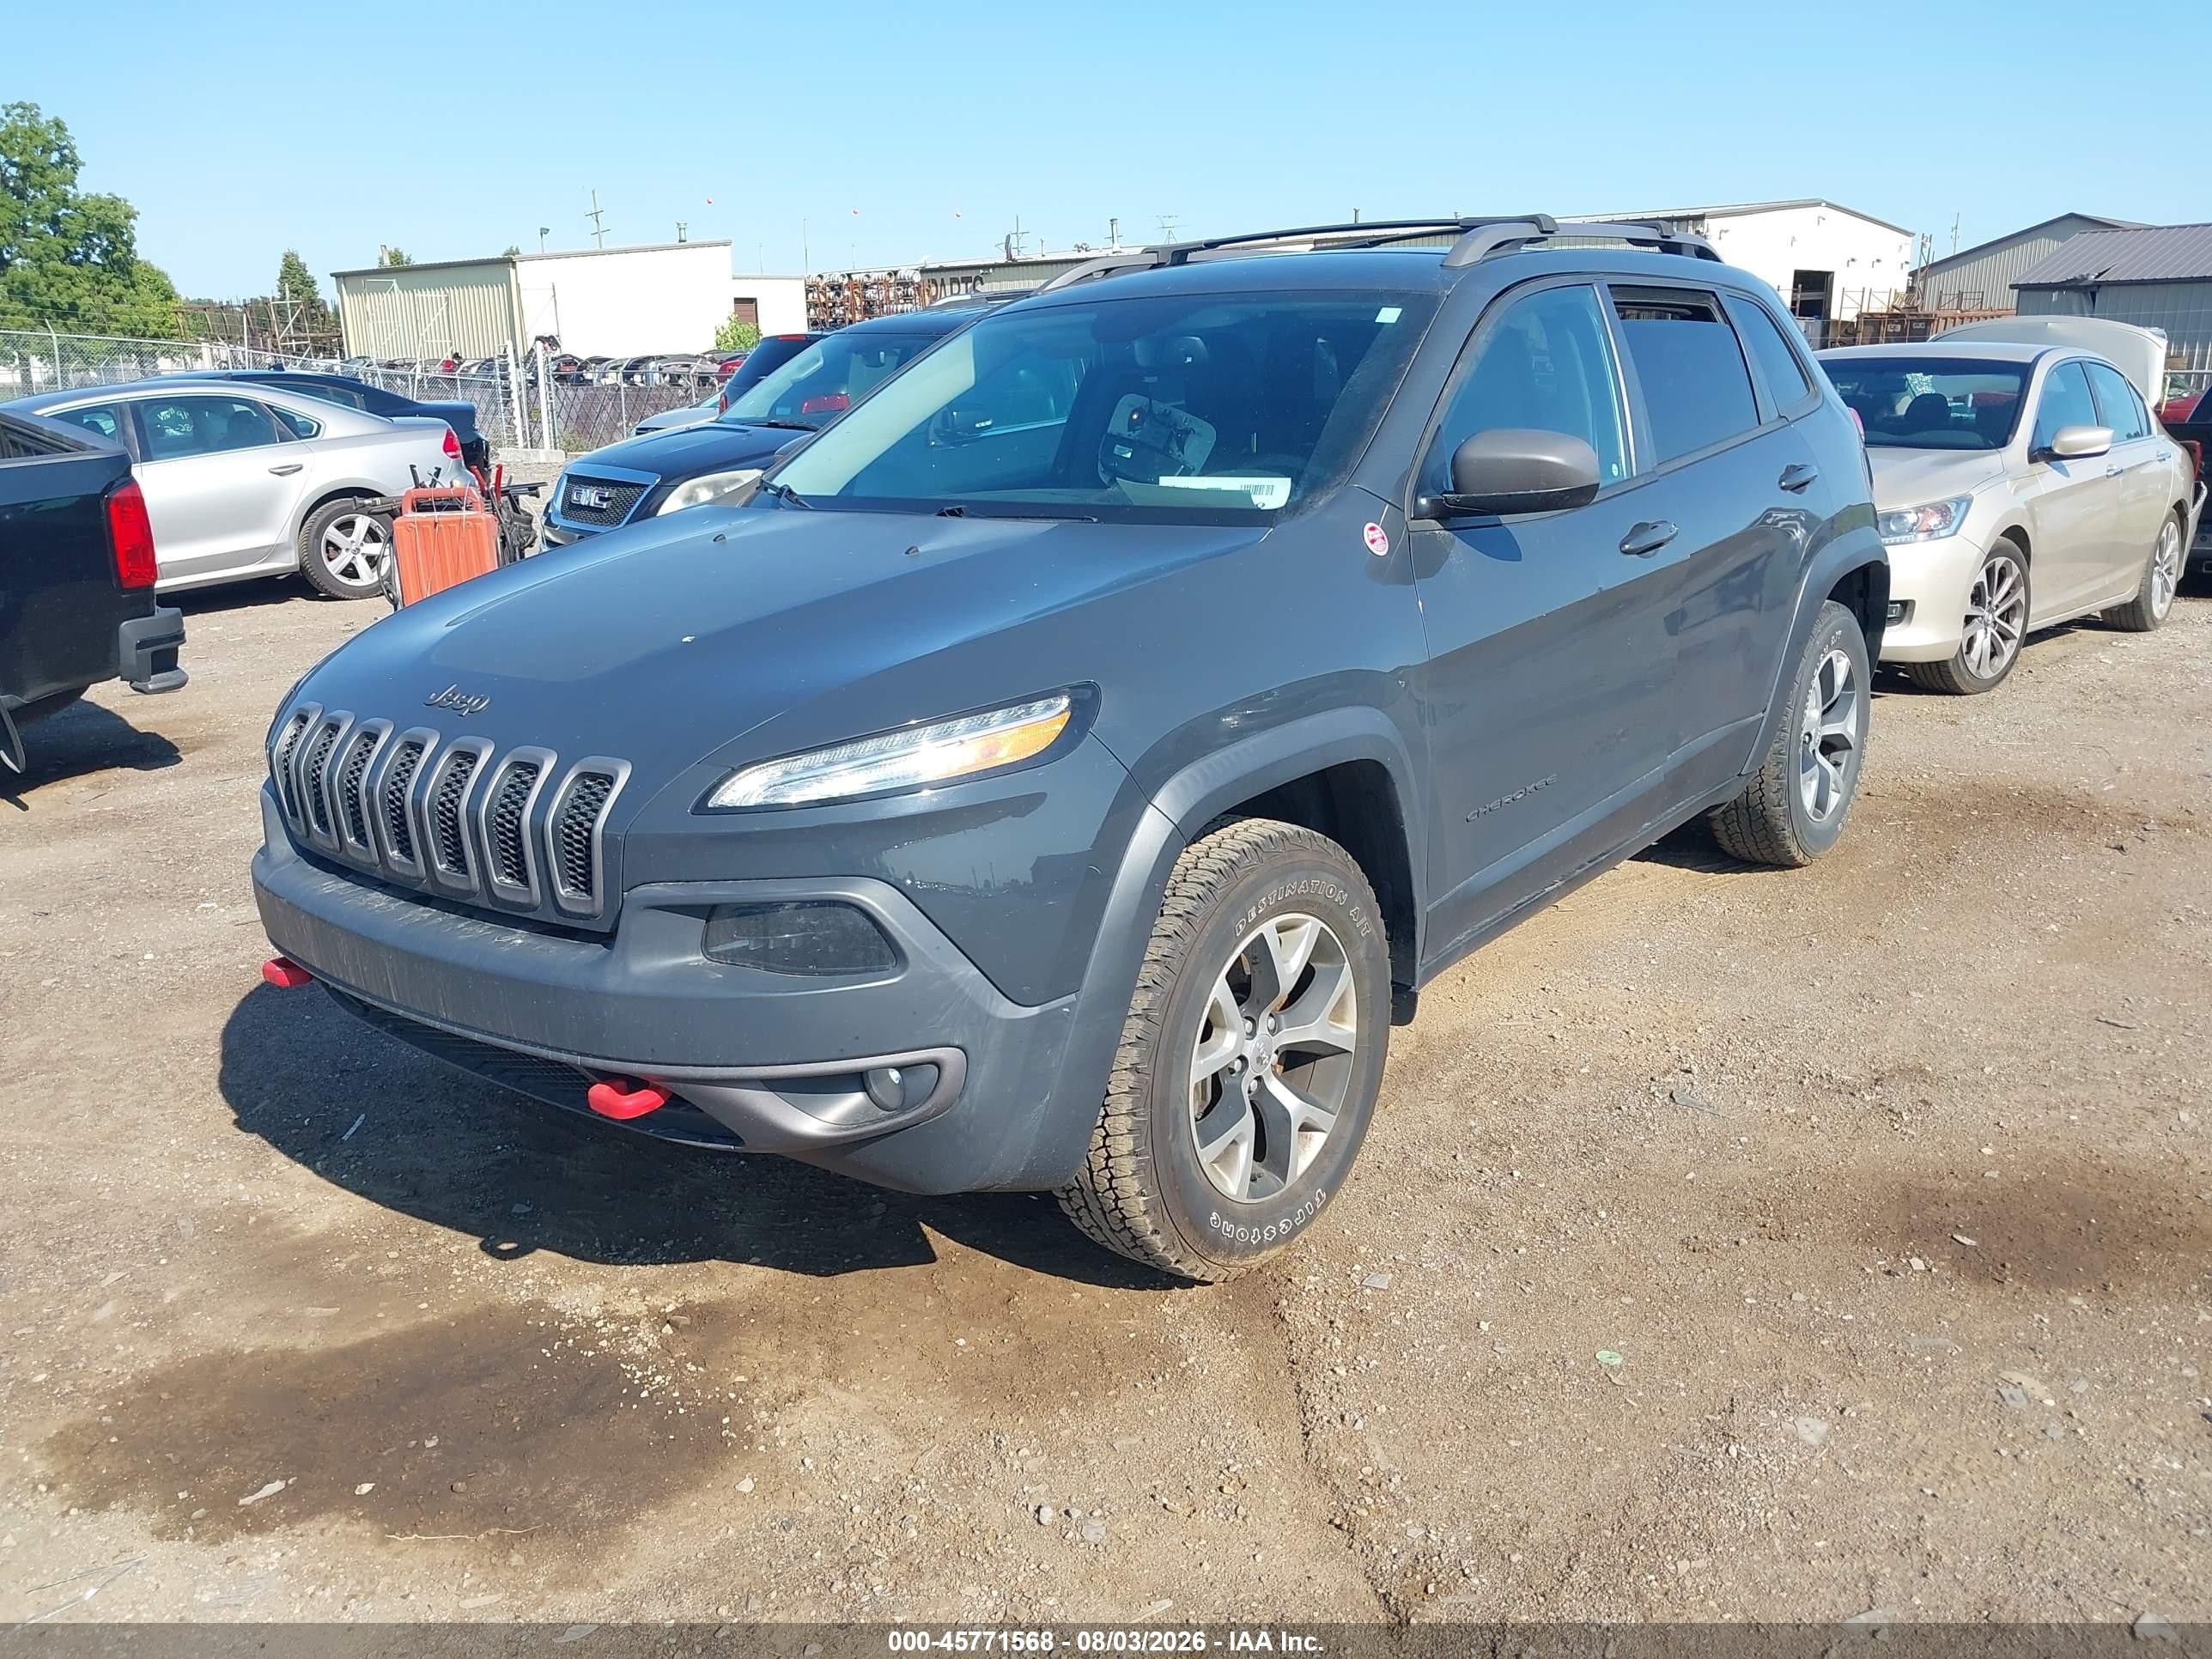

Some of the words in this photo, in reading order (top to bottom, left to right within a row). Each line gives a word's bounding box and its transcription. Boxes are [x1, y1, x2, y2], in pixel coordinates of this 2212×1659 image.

[571, 487, 610, 509] GMC
[423, 684, 491, 717] Jeep
[1466, 773, 1559, 823] CHEROKEE
[1235, 880, 1348, 937] DESTINATION
[1349, 907, 1371, 937] A/T
[1210, 1188, 1327, 1244] Firestone
